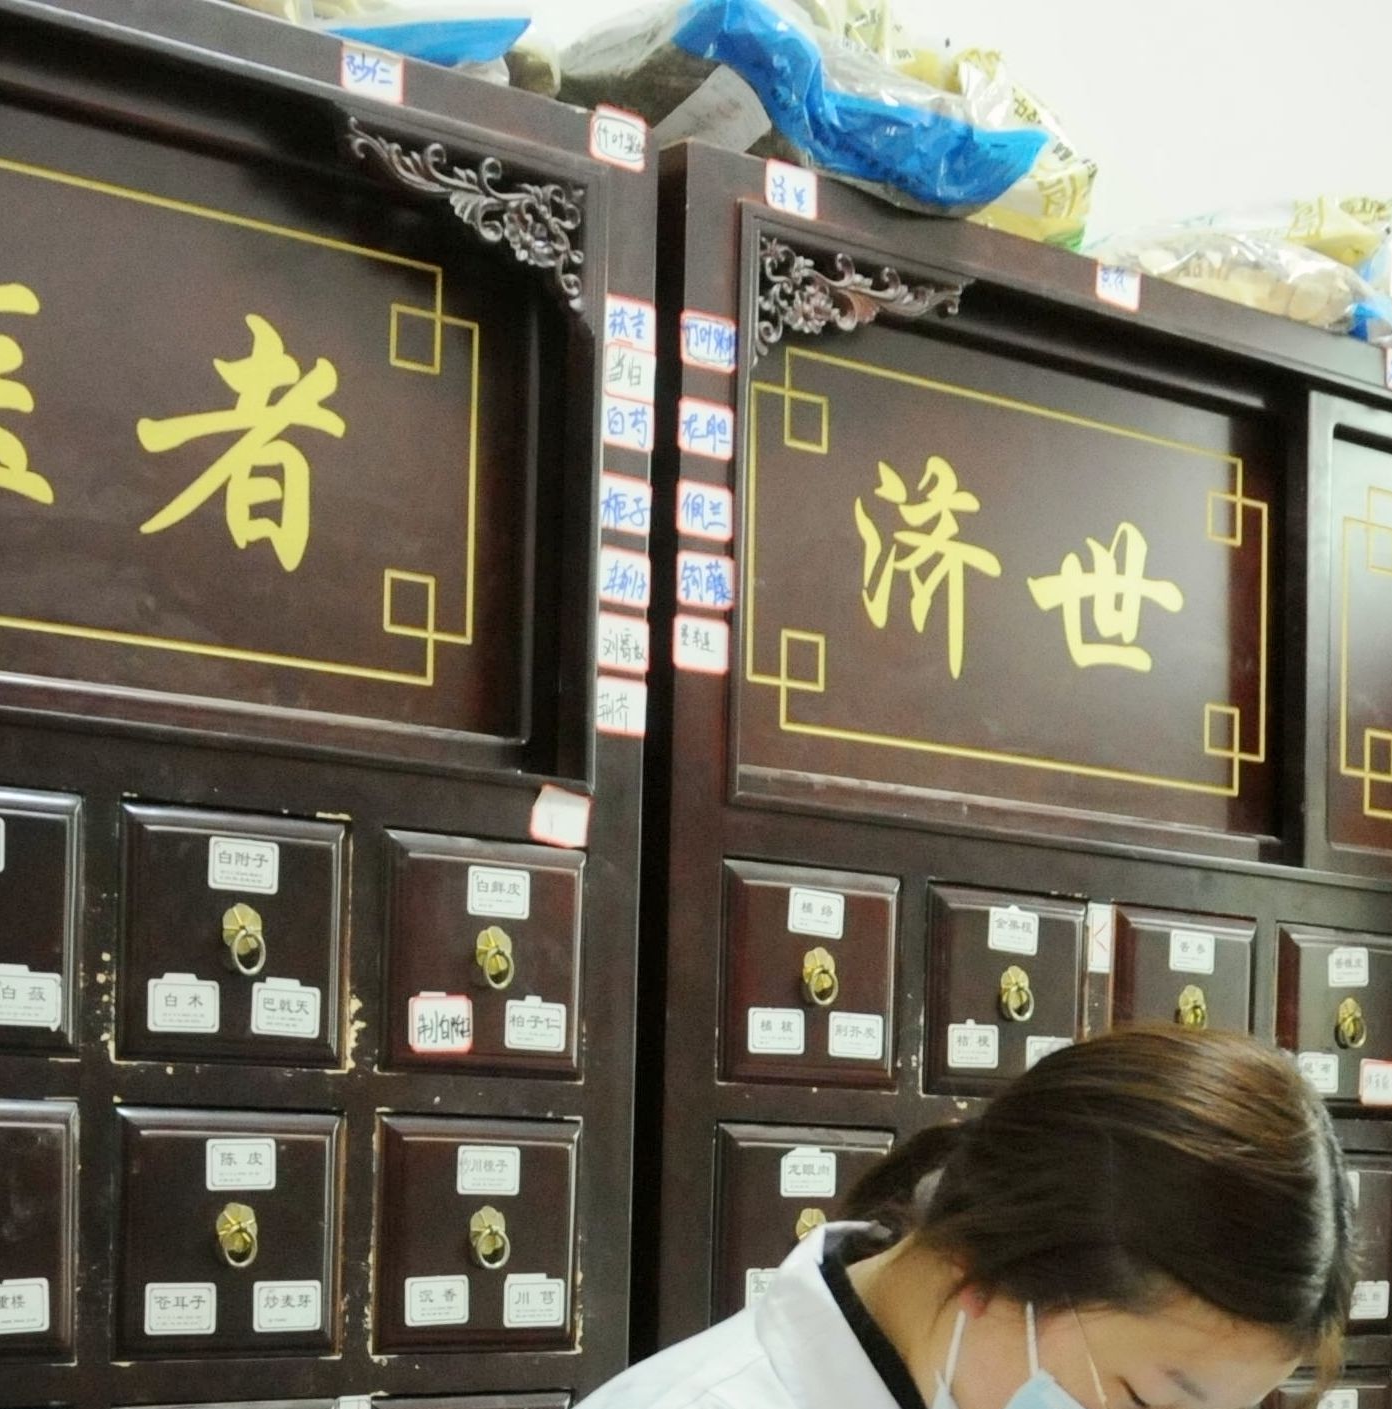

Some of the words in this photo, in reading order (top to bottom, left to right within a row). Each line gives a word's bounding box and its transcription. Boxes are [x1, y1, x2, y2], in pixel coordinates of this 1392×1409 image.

[855, 456, 1185, 679] 济世
[217, 849, 269, 869] 白附子
[509, 1013, 561, 1031] 柏子仁
[955, 1034, 990, 1048] 桔梗
[219, 1150, 263, 1167] 陈皮
[152, 1293, 207, 1311] 苍耳子
[418, 1286, 457, 1304] 沉香
